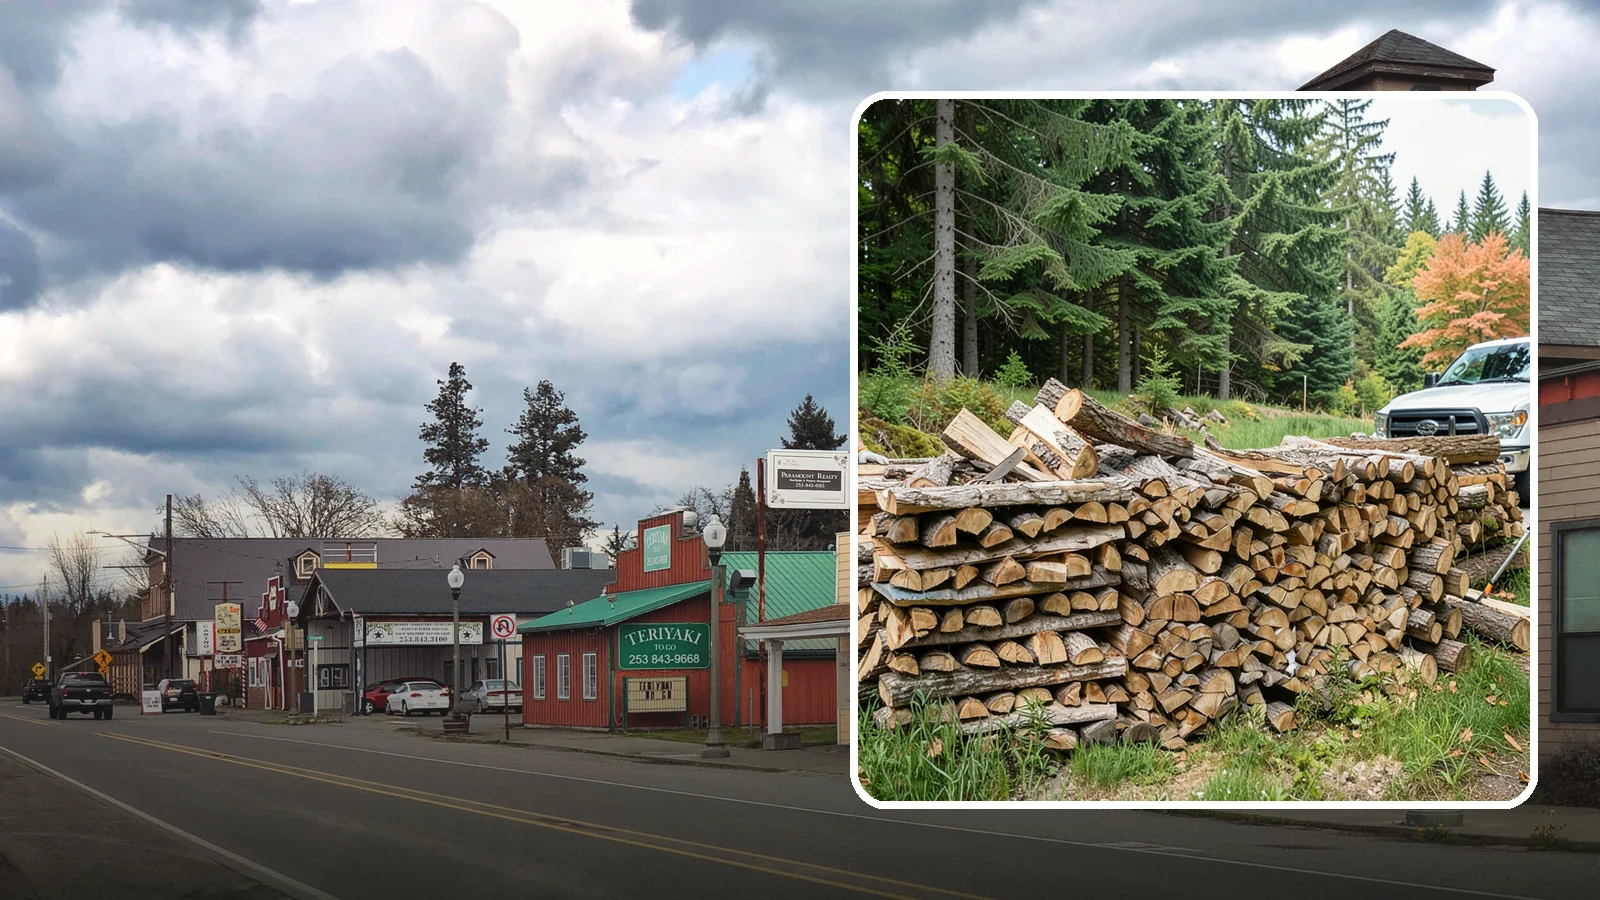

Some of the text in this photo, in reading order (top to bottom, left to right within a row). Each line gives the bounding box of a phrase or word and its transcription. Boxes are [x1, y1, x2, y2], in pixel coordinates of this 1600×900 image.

[817, 472, 839, 480] REALTY
[624, 627, 702, 646] TERIYAKI
[628, 653, 700, 664] 253 843-9668
